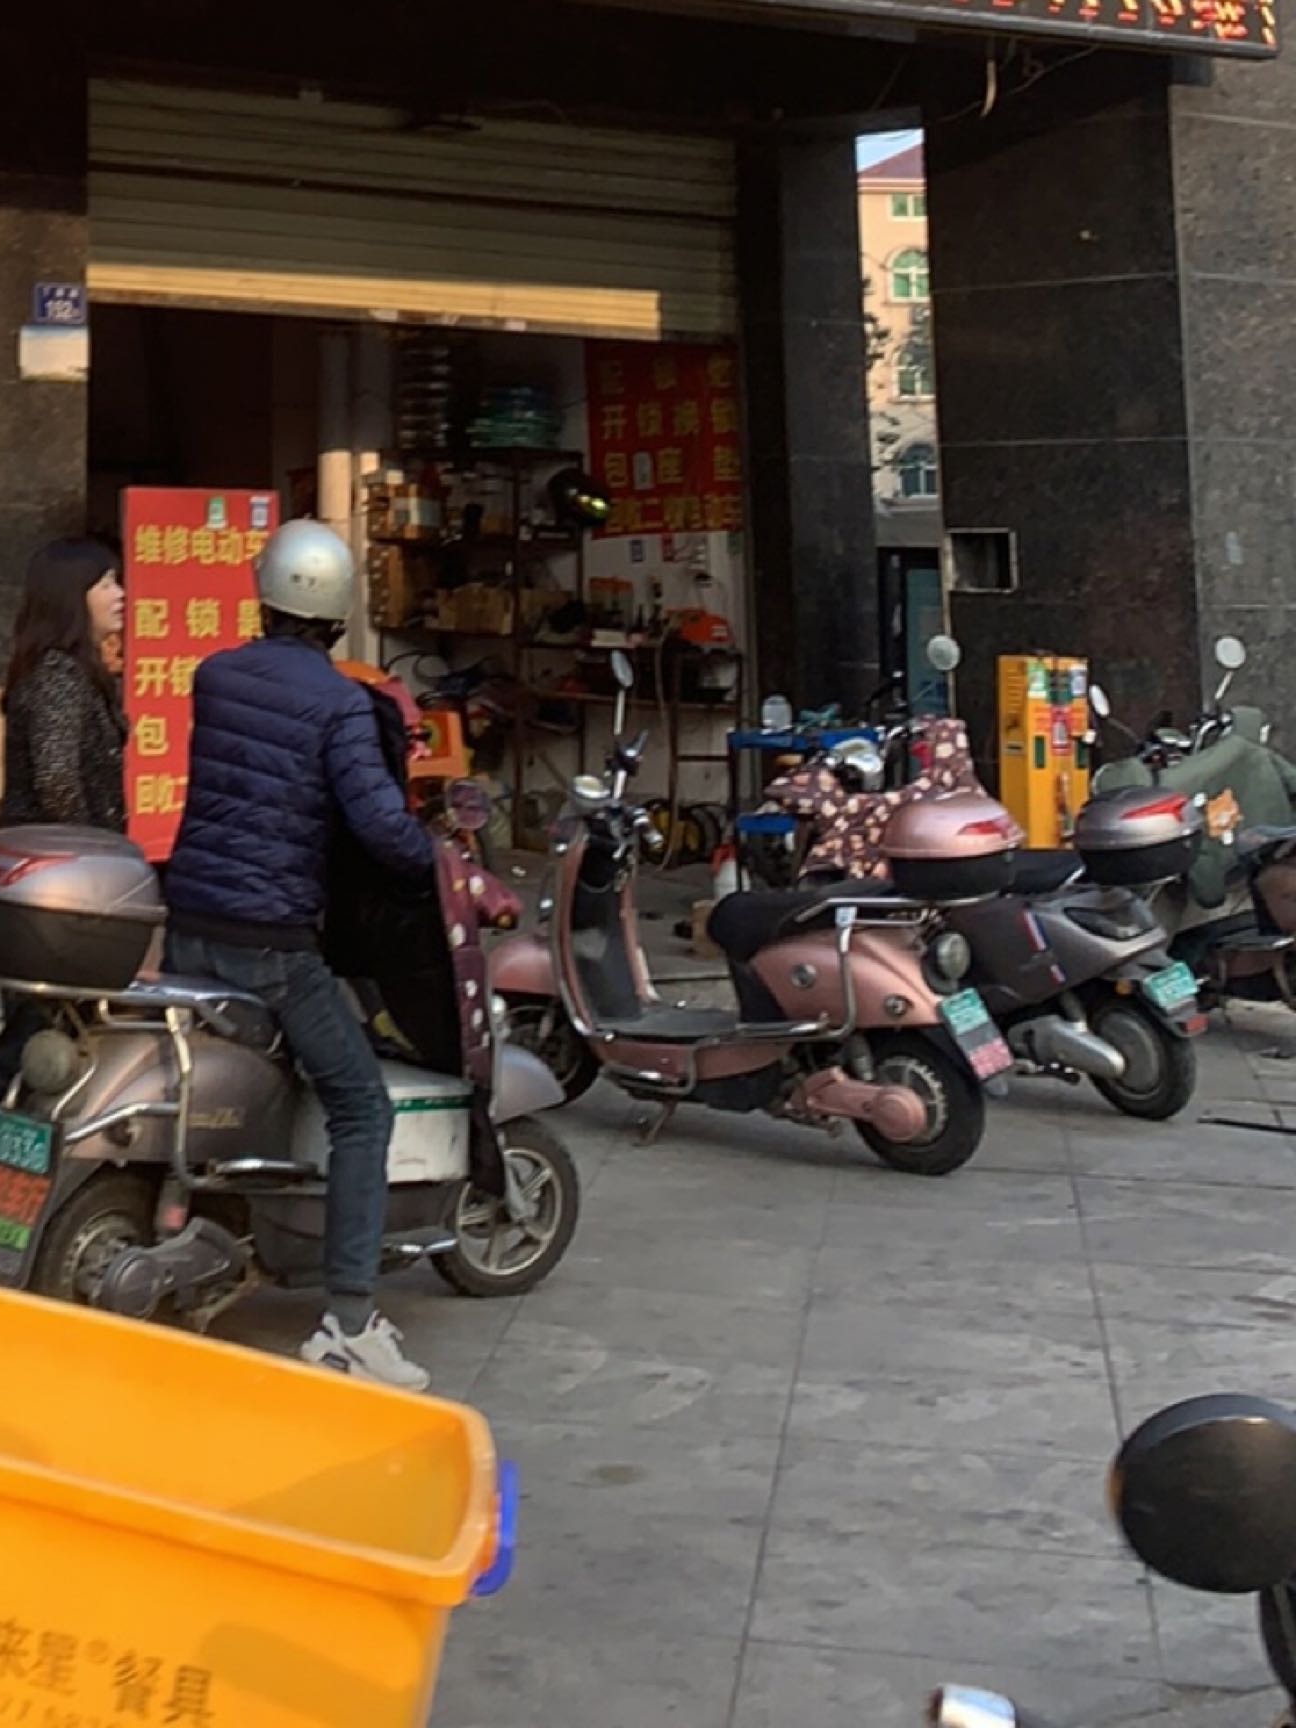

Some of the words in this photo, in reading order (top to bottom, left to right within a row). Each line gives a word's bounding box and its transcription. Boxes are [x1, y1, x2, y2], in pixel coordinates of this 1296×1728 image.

[135, 525, 271, 566] 维修电动车
[135, 715, 170, 757] 包
